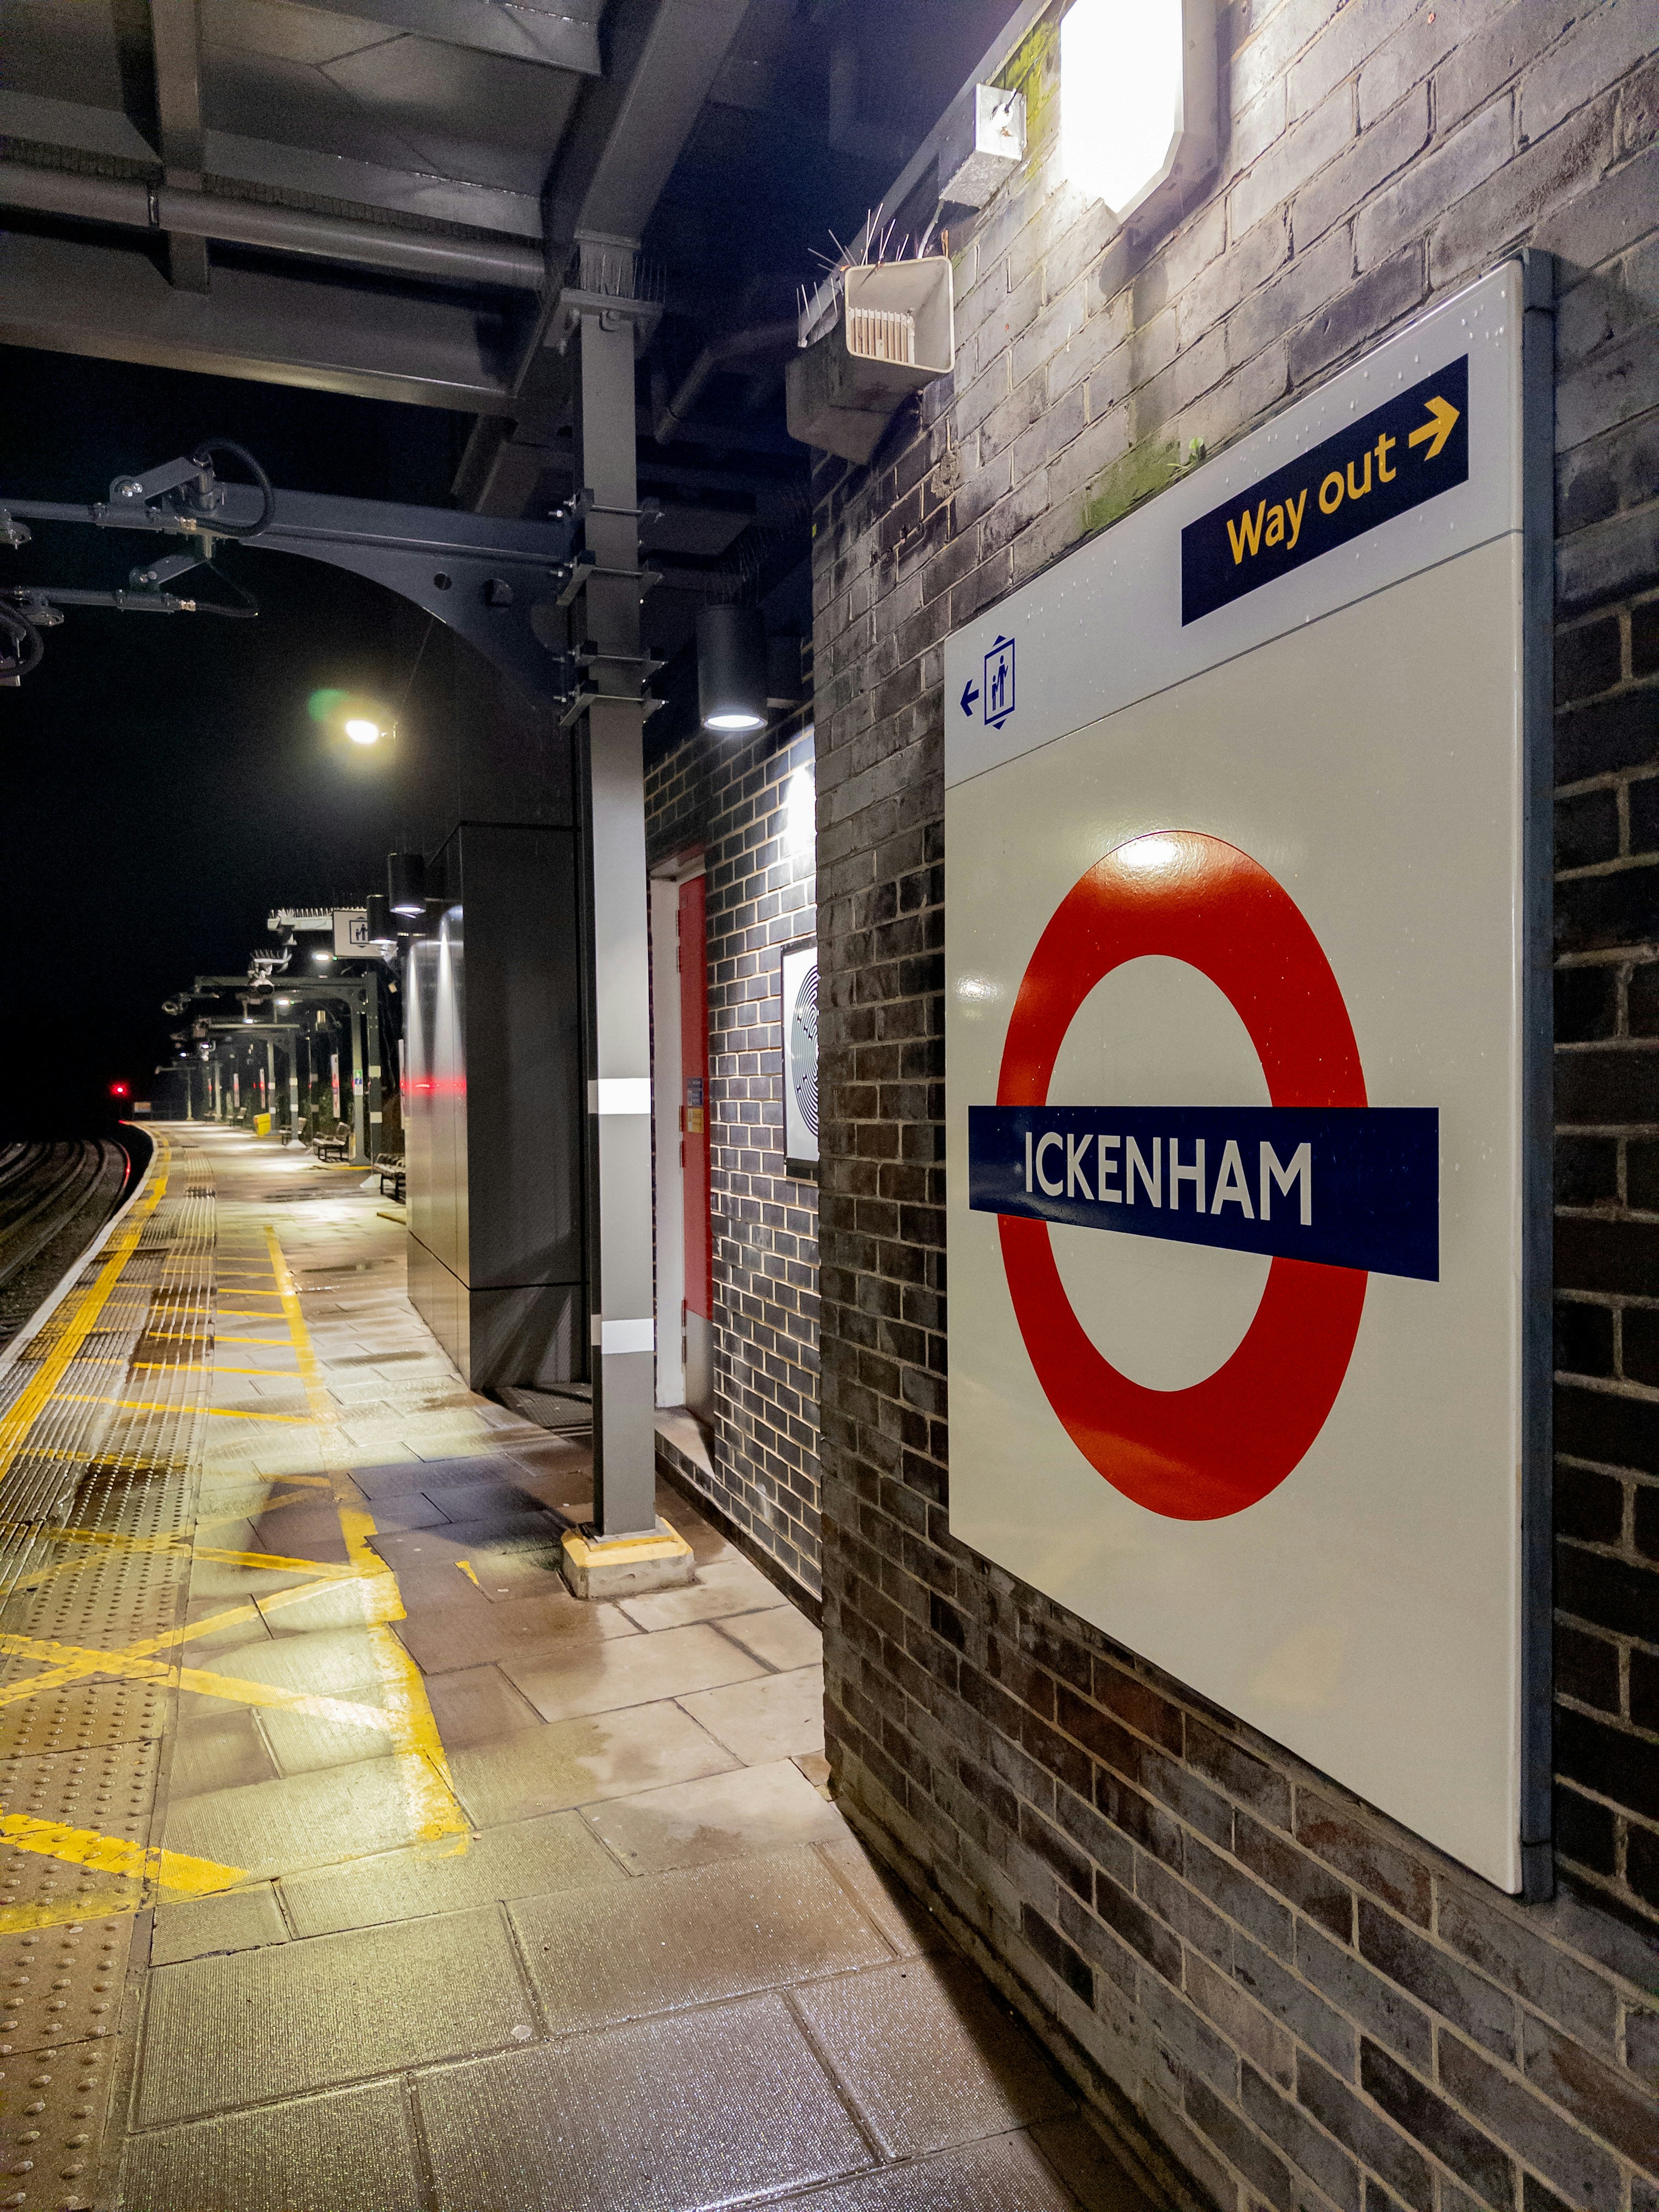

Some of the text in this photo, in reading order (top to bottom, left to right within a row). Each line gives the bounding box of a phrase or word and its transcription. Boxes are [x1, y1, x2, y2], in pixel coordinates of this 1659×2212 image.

[1226, 433, 1396, 565] Way out
[1025, 1131, 1312, 1226] ICKENHAM
